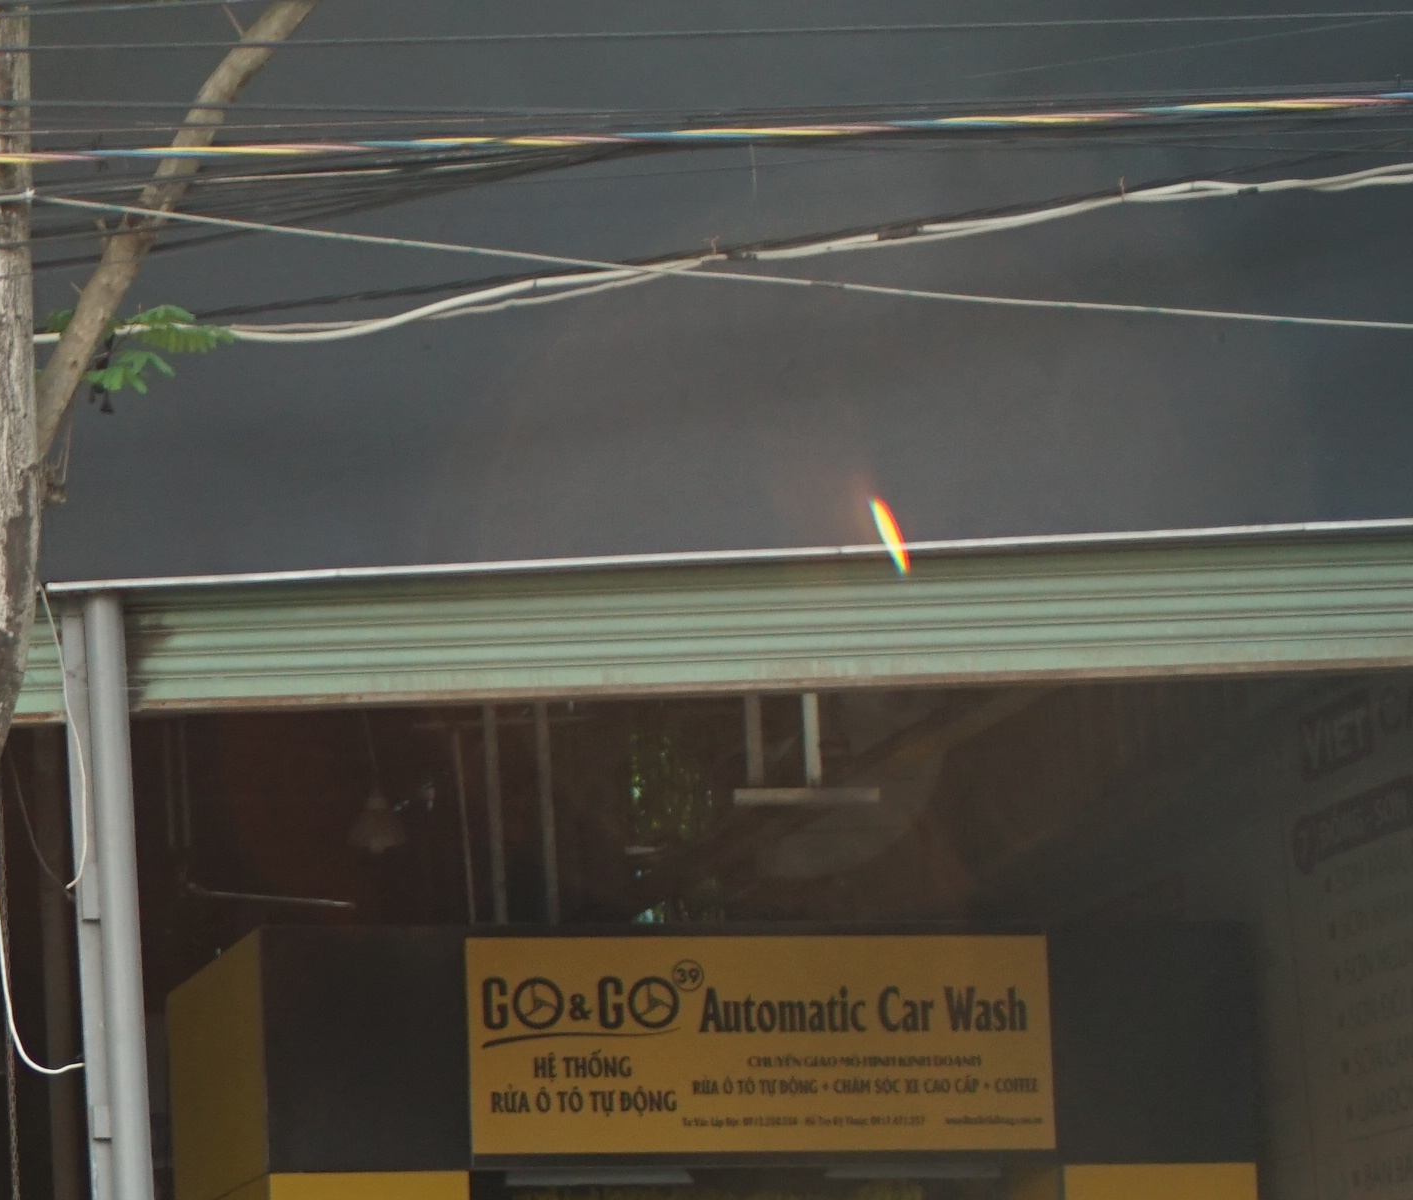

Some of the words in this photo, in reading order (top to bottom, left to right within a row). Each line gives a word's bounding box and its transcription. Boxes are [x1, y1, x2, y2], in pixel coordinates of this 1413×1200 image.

[698, 986, 867, 1033] Automatic
[877, 986, 931, 1033] Car
[944, 985, 1029, 1032] Wash
[534, 1052, 557, 1082] HỆ
[562, 1049, 632, 1078] THỐNG
[491, 1084, 531, 1113] RỬA
[535, 1086, 552, 1113] Ô
[557, 1086, 584, 1113] TÔ
[590, 1089, 616, 1118] TỰ
[620, 1085, 678, 1118] ĐỘNG
[924, 1078, 951, 1093] CAO
